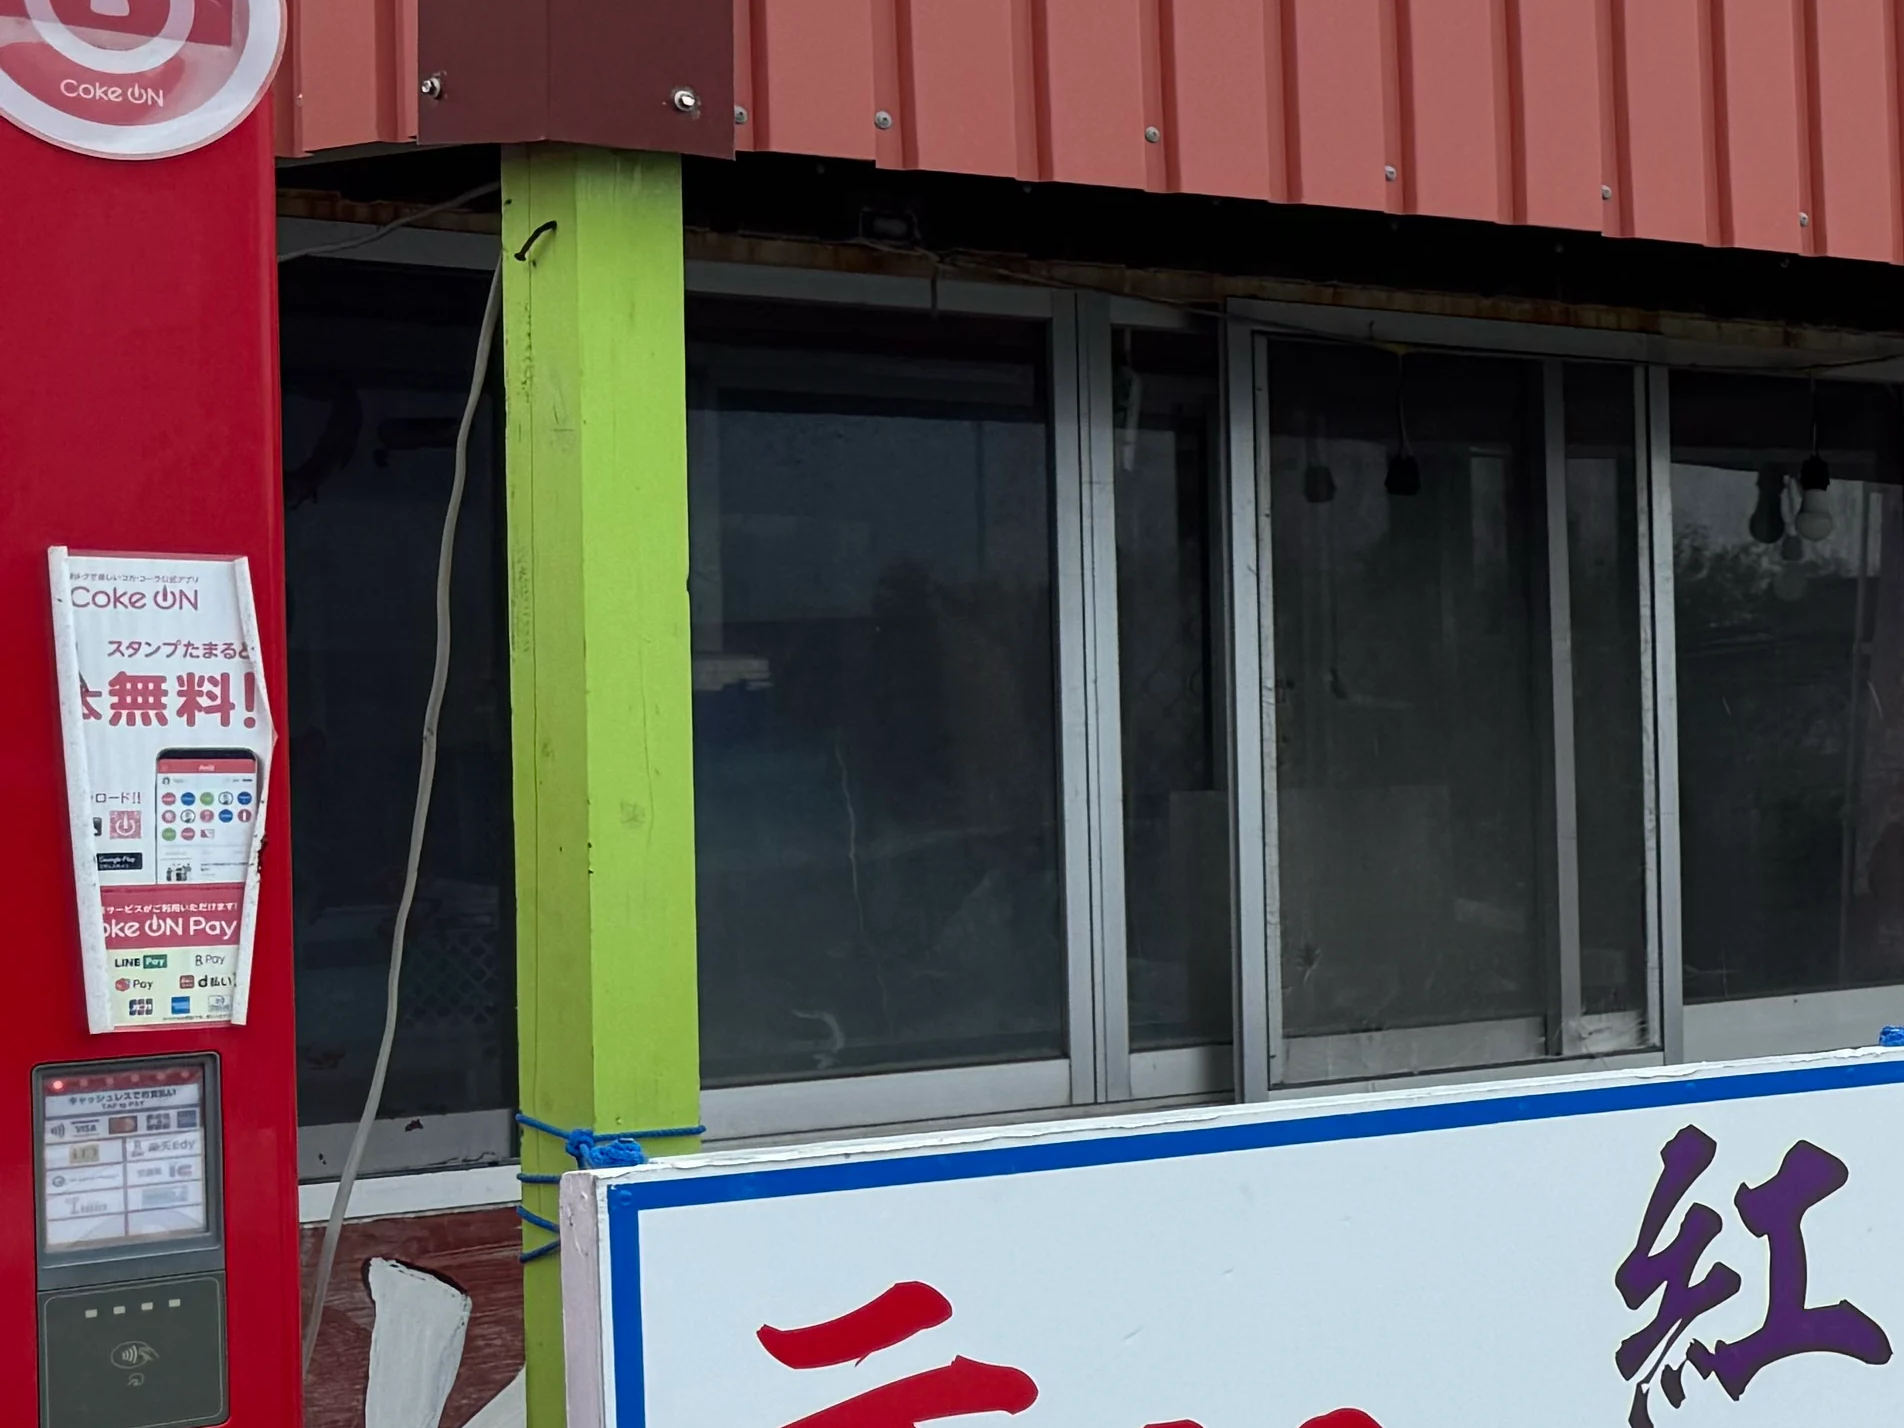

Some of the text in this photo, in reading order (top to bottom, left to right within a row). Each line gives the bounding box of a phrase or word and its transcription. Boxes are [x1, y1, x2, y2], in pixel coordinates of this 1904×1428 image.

[60, 78, 164, 109] Coke ON
[71, 584, 199, 611] Coke ON
[145, 915, 183, 936] ON
[190, 916, 238, 941] Pay
[114, 955, 166, 969] LINE Pay
[206, 954, 226, 966] Pay
[132, 979, 154, 991] Pay
[74, 1123, 97, 1134] VISA
